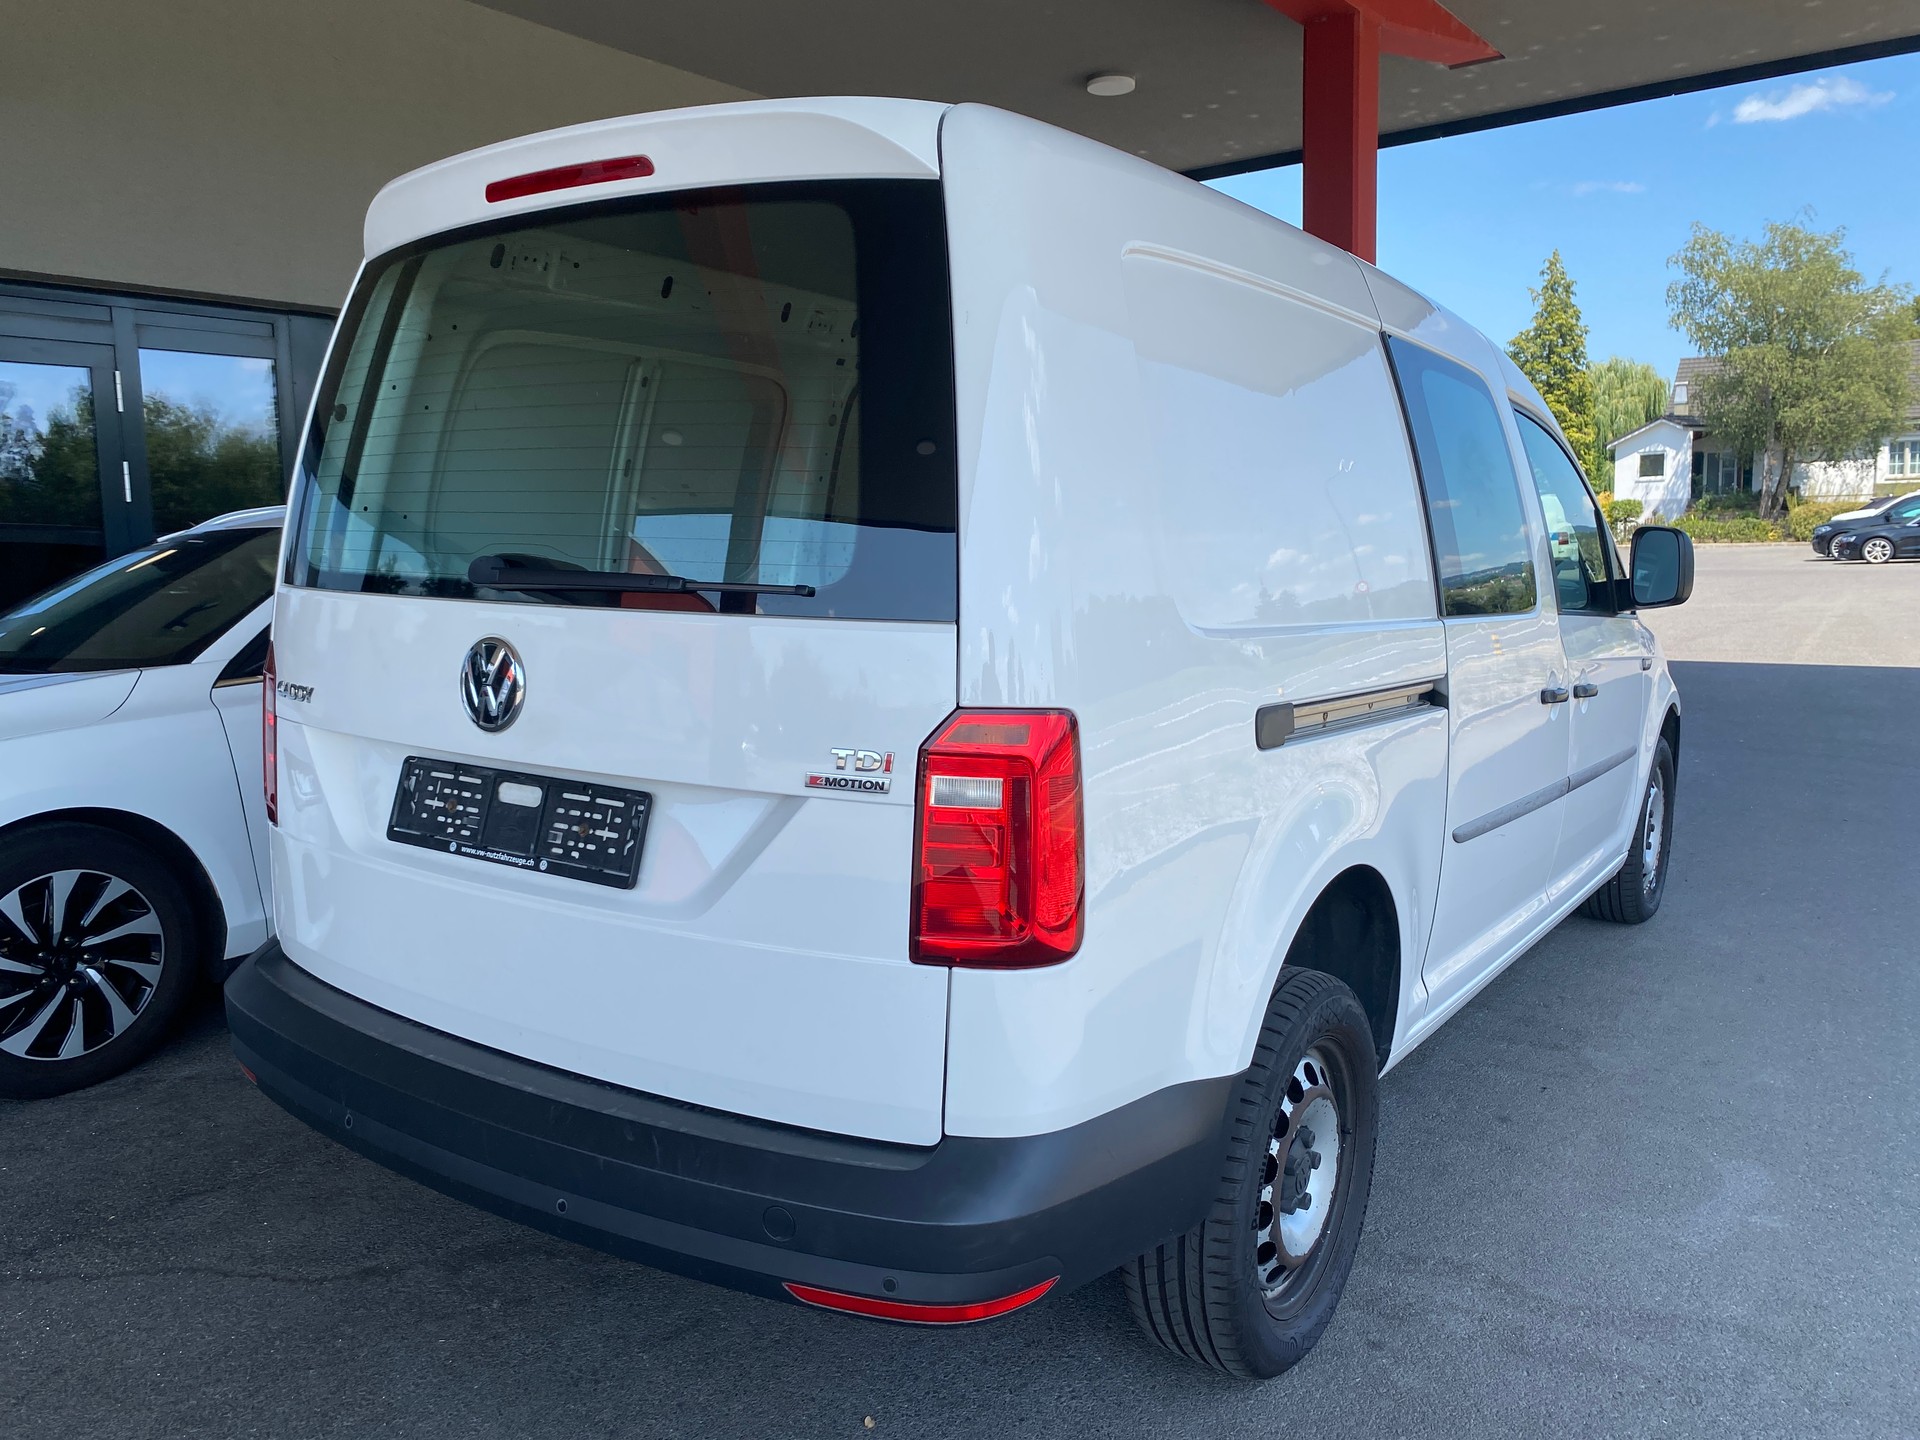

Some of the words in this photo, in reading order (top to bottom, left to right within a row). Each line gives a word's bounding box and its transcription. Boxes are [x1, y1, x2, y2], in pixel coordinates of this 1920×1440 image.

[829, 747, 895, 774] TDI
[813, 774, 886, 791] 4MOTION
[460, 845, 535, 867] www.vw-nutzfahrzeuge.ch
